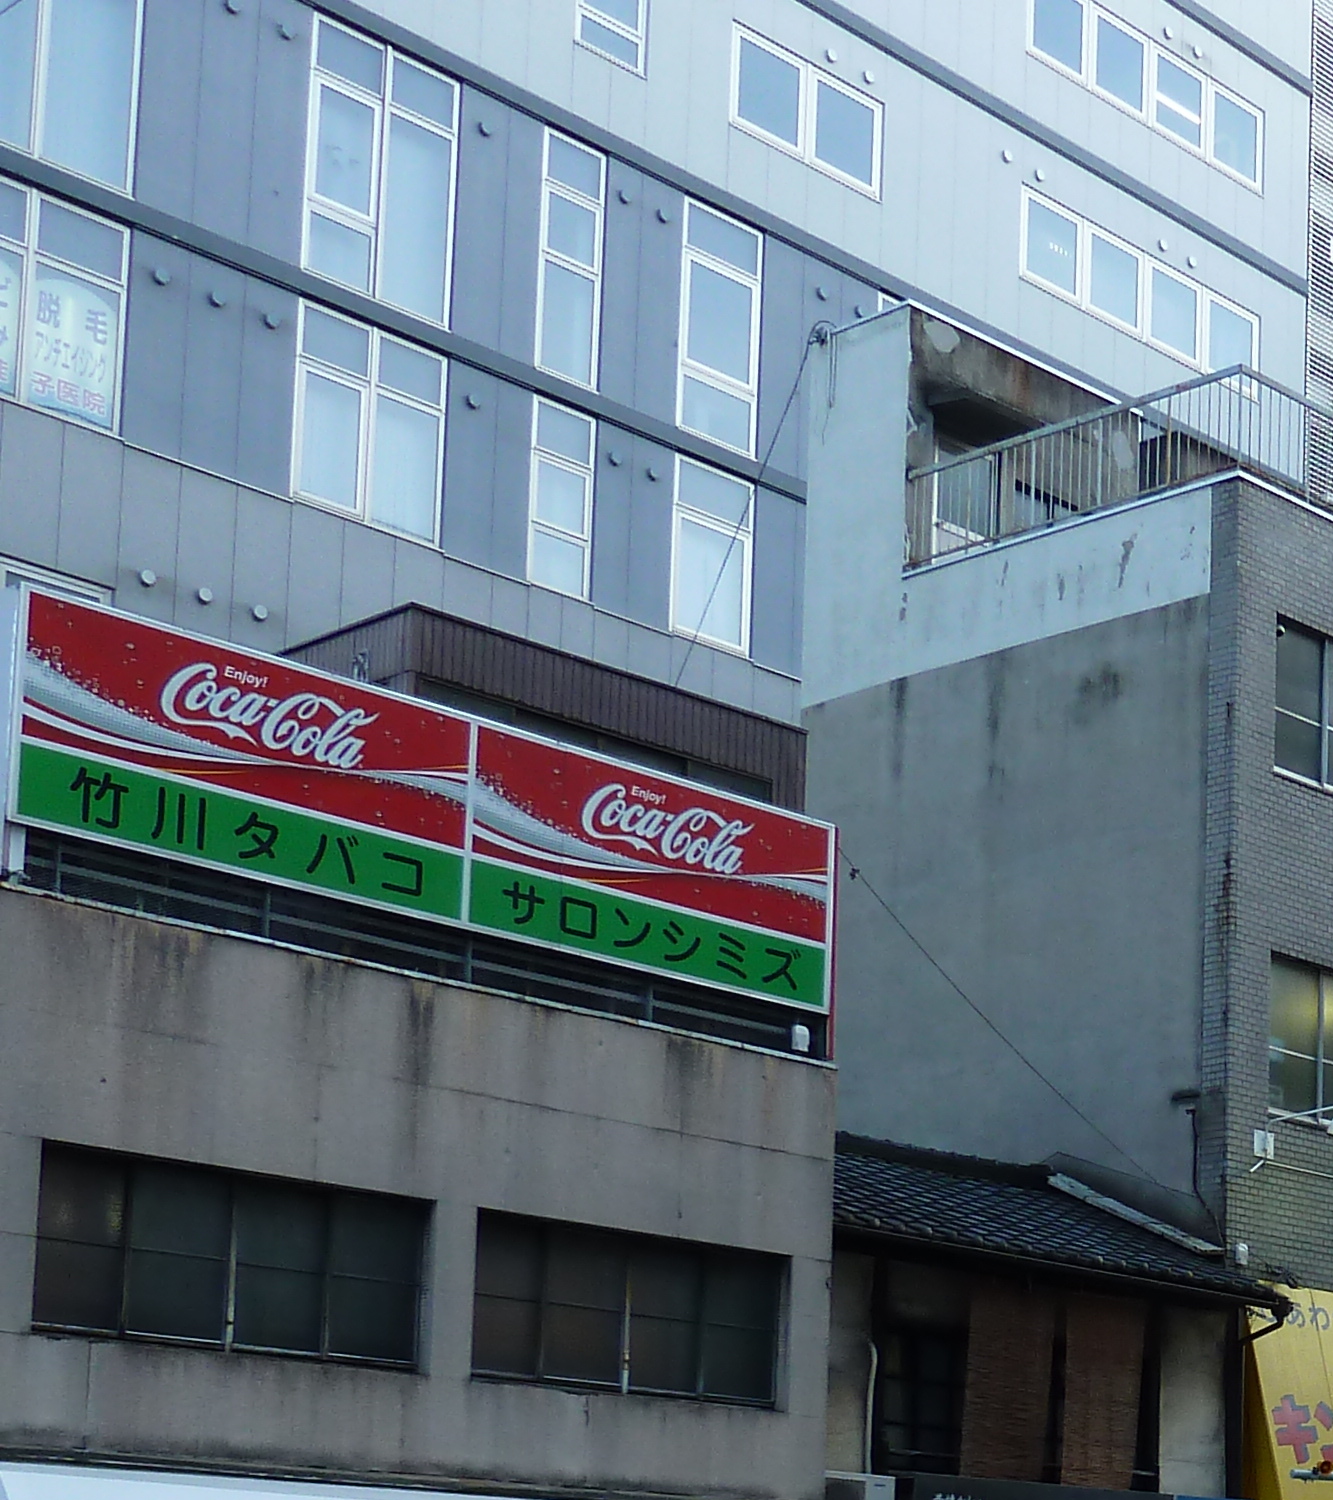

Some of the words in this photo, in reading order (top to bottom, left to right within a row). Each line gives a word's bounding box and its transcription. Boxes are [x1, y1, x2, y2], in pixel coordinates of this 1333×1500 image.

[161, 663, 380, 769] Coca-Cola
[224, 666, 269, 688] Enjoy!
[70, 766, 424, 899] 竹川タバコ
[581, 783, 755, 874] Coca-Cola
[631, 786, 666, 805] Enjoy!
[503, 880, 802, 992] サロンシミズ
